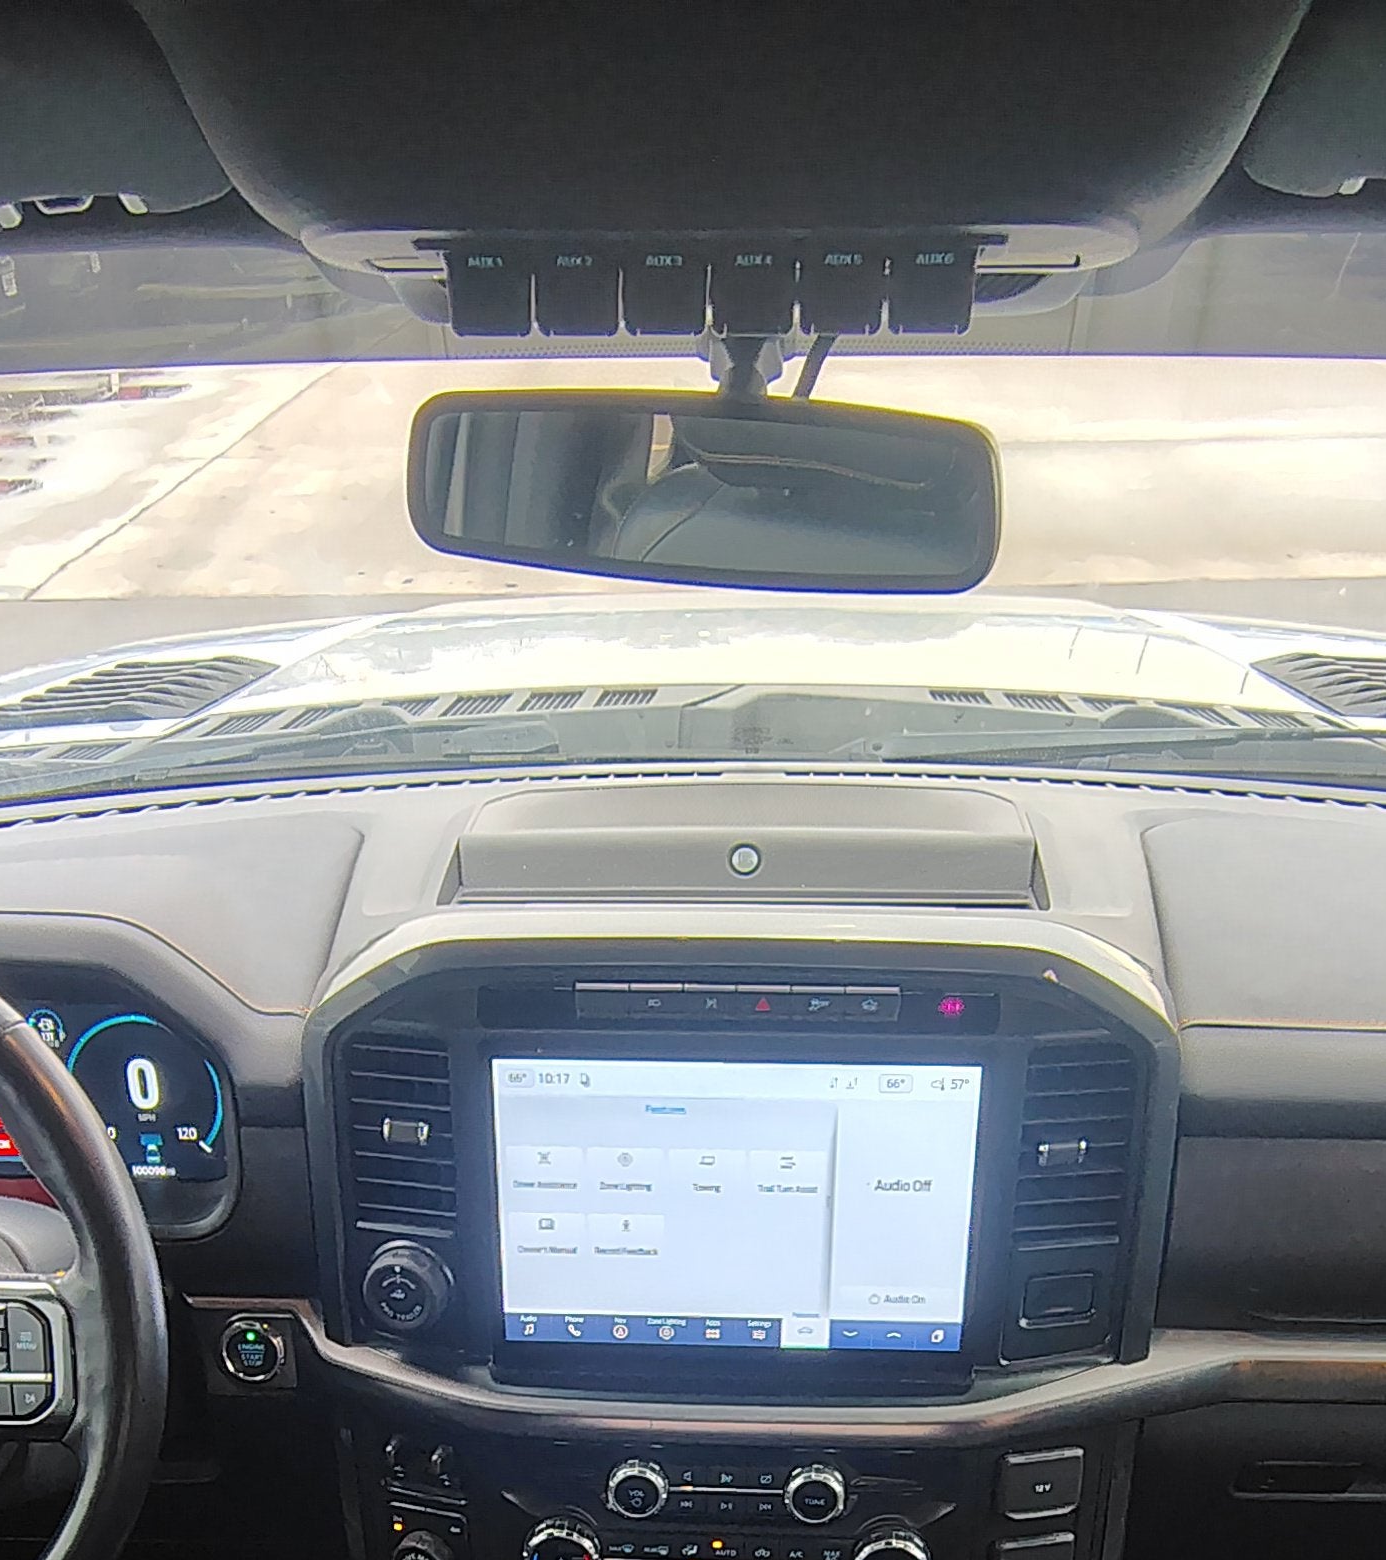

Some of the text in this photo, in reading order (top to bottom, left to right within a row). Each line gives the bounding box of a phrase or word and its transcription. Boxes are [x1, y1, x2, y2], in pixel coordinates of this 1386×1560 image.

[127, 1058, 159, 1110] 0
[538, 1073, 570, 1084] 10:17
[950, 1078, 970, 1089] 57°
[176, 1127, 197, 1140] 120
[873, 1179, 933, 1193] Audio Off
[715, 1549, 737, 1557] AUTO
[788, 1550, 804, 1559] A/C
